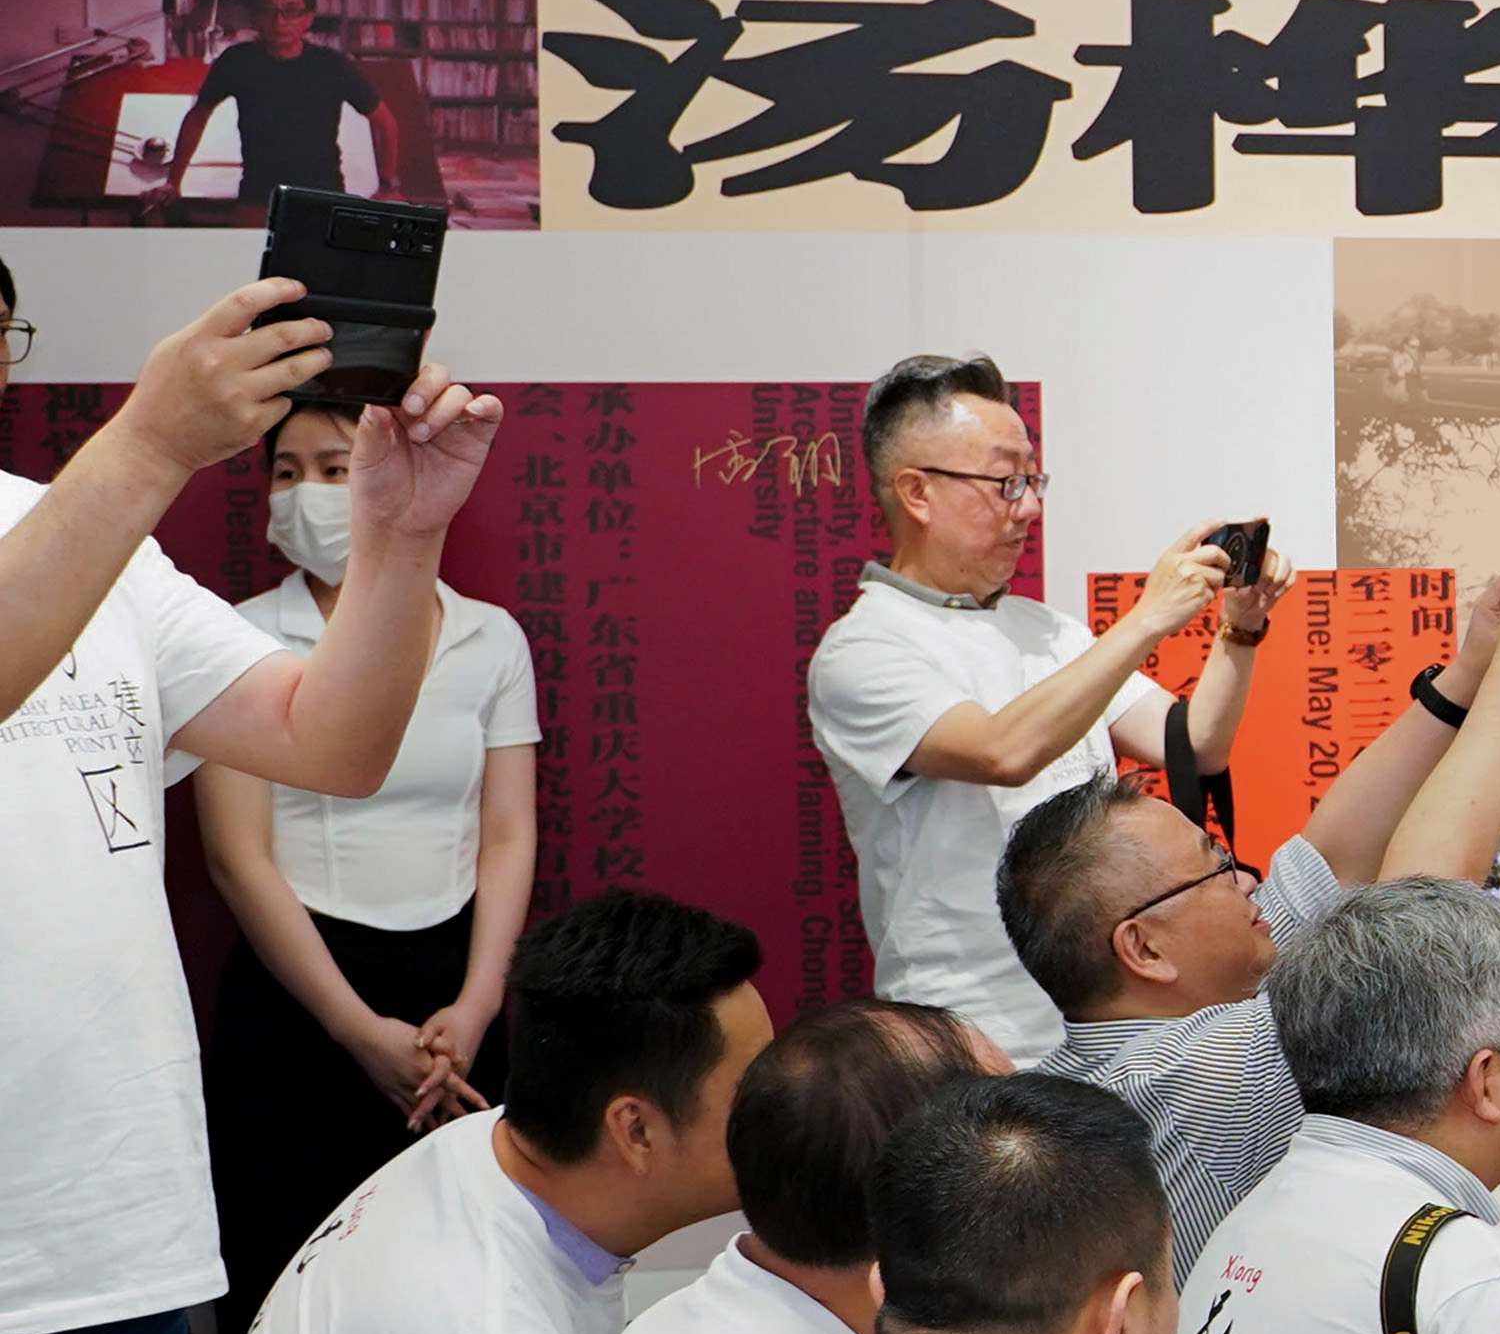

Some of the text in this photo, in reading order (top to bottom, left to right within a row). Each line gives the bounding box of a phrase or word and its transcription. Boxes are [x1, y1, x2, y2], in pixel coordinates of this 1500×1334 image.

[793, 589, 820, 646] and
[1305, 574, 1338, 656] Time:
[1302, 666, 1340, 731] May
[1220, 1254, 1263, 1294] Xiong
